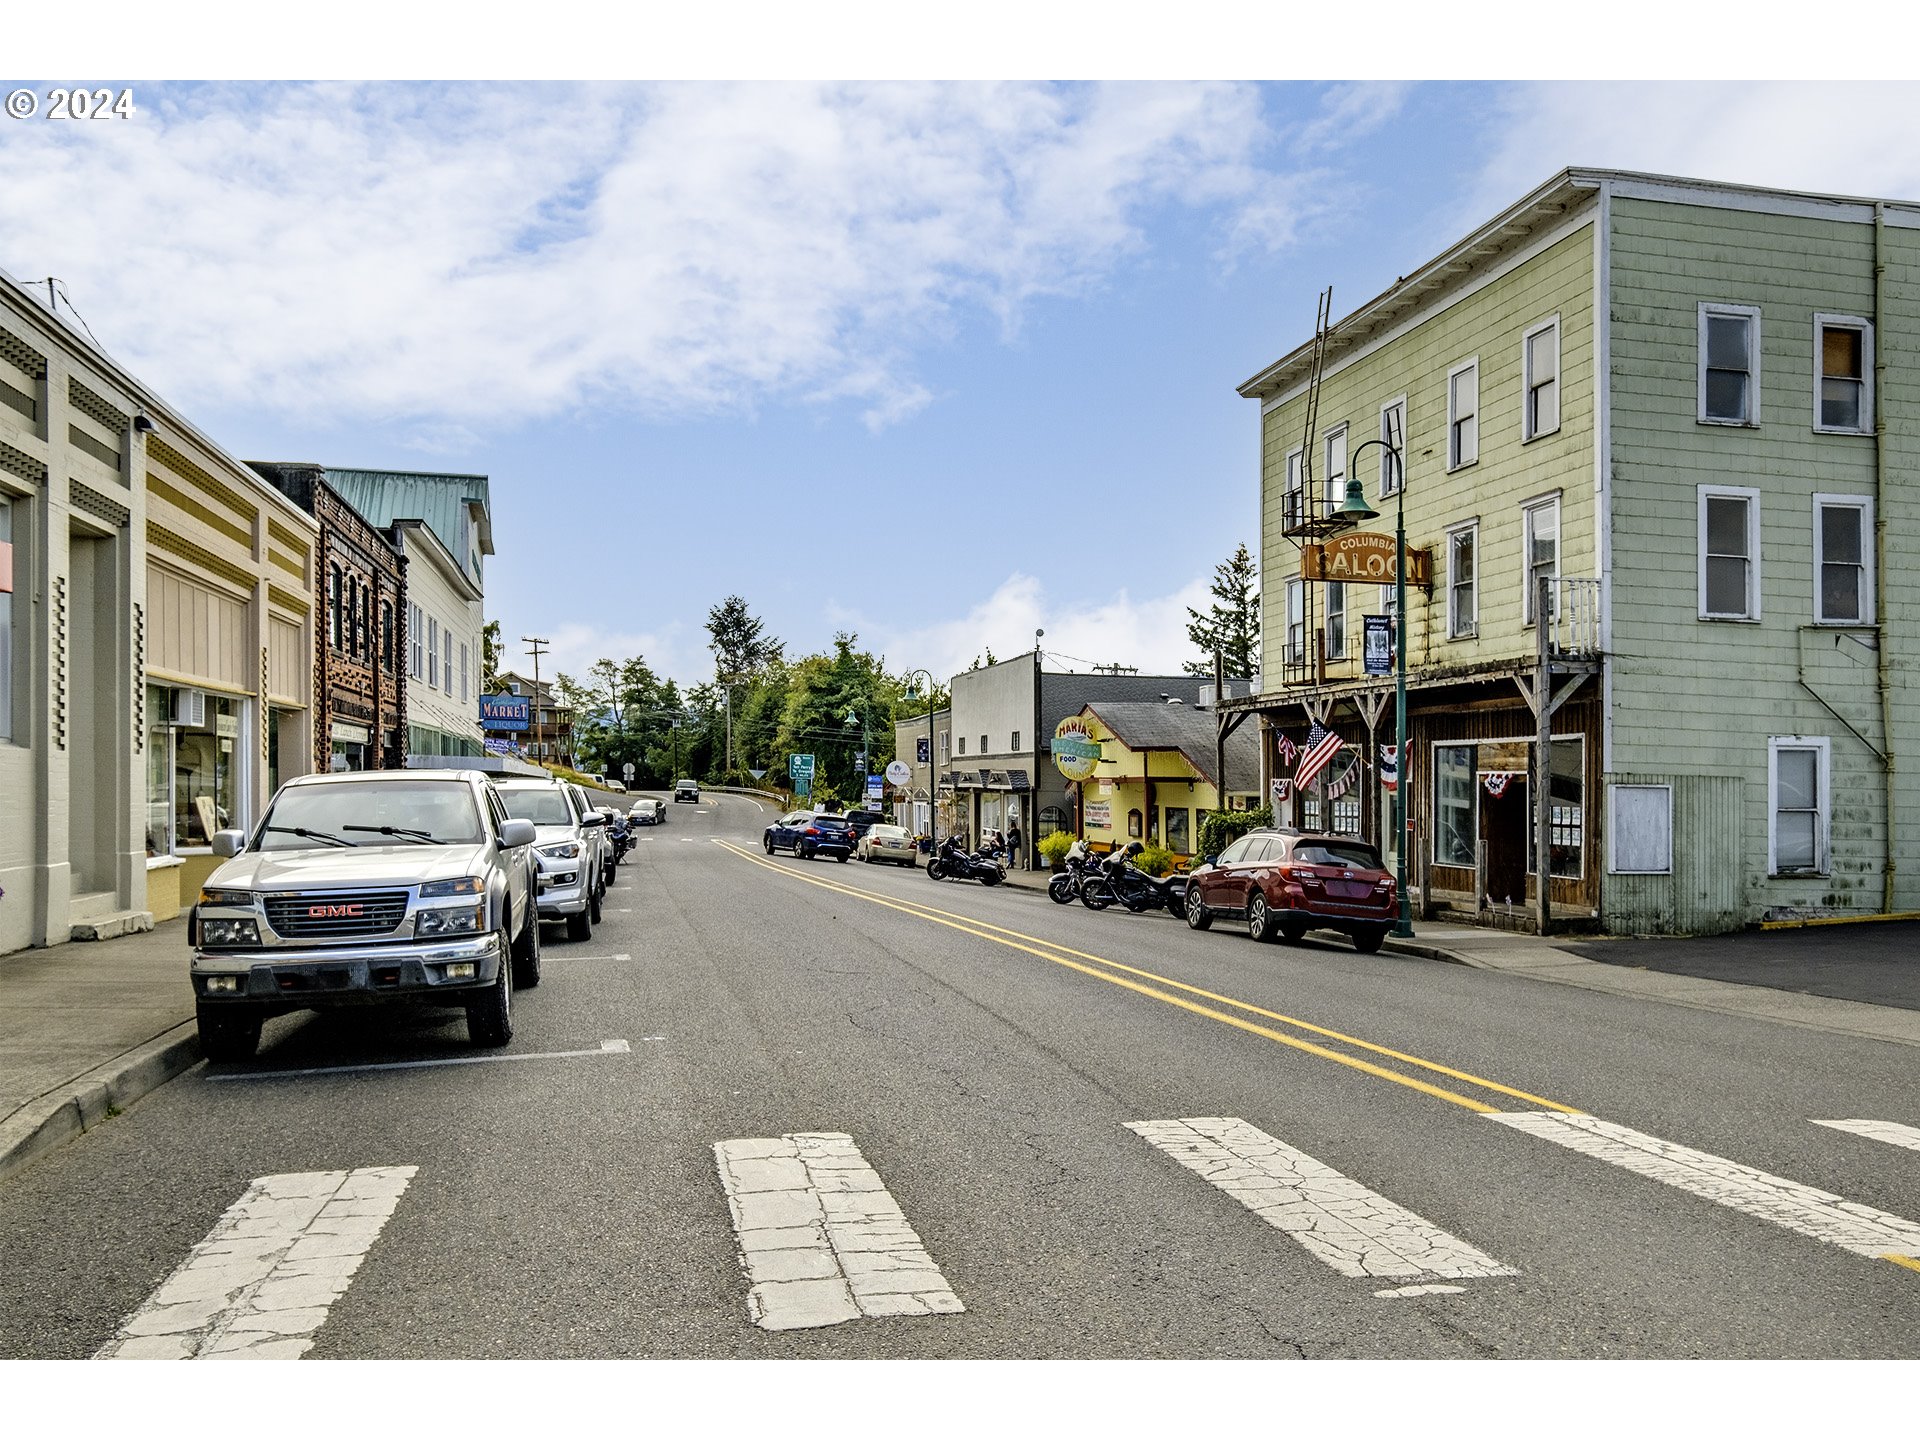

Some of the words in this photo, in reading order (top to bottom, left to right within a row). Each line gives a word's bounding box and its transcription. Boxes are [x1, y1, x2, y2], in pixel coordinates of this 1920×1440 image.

[1340, 536, 1396, 553] COLUMBIA
[483, 702, 527, 718] MARKET
[494, 720, 527, 729] LIQUOR
[309, 904, 364, 918] GMC
